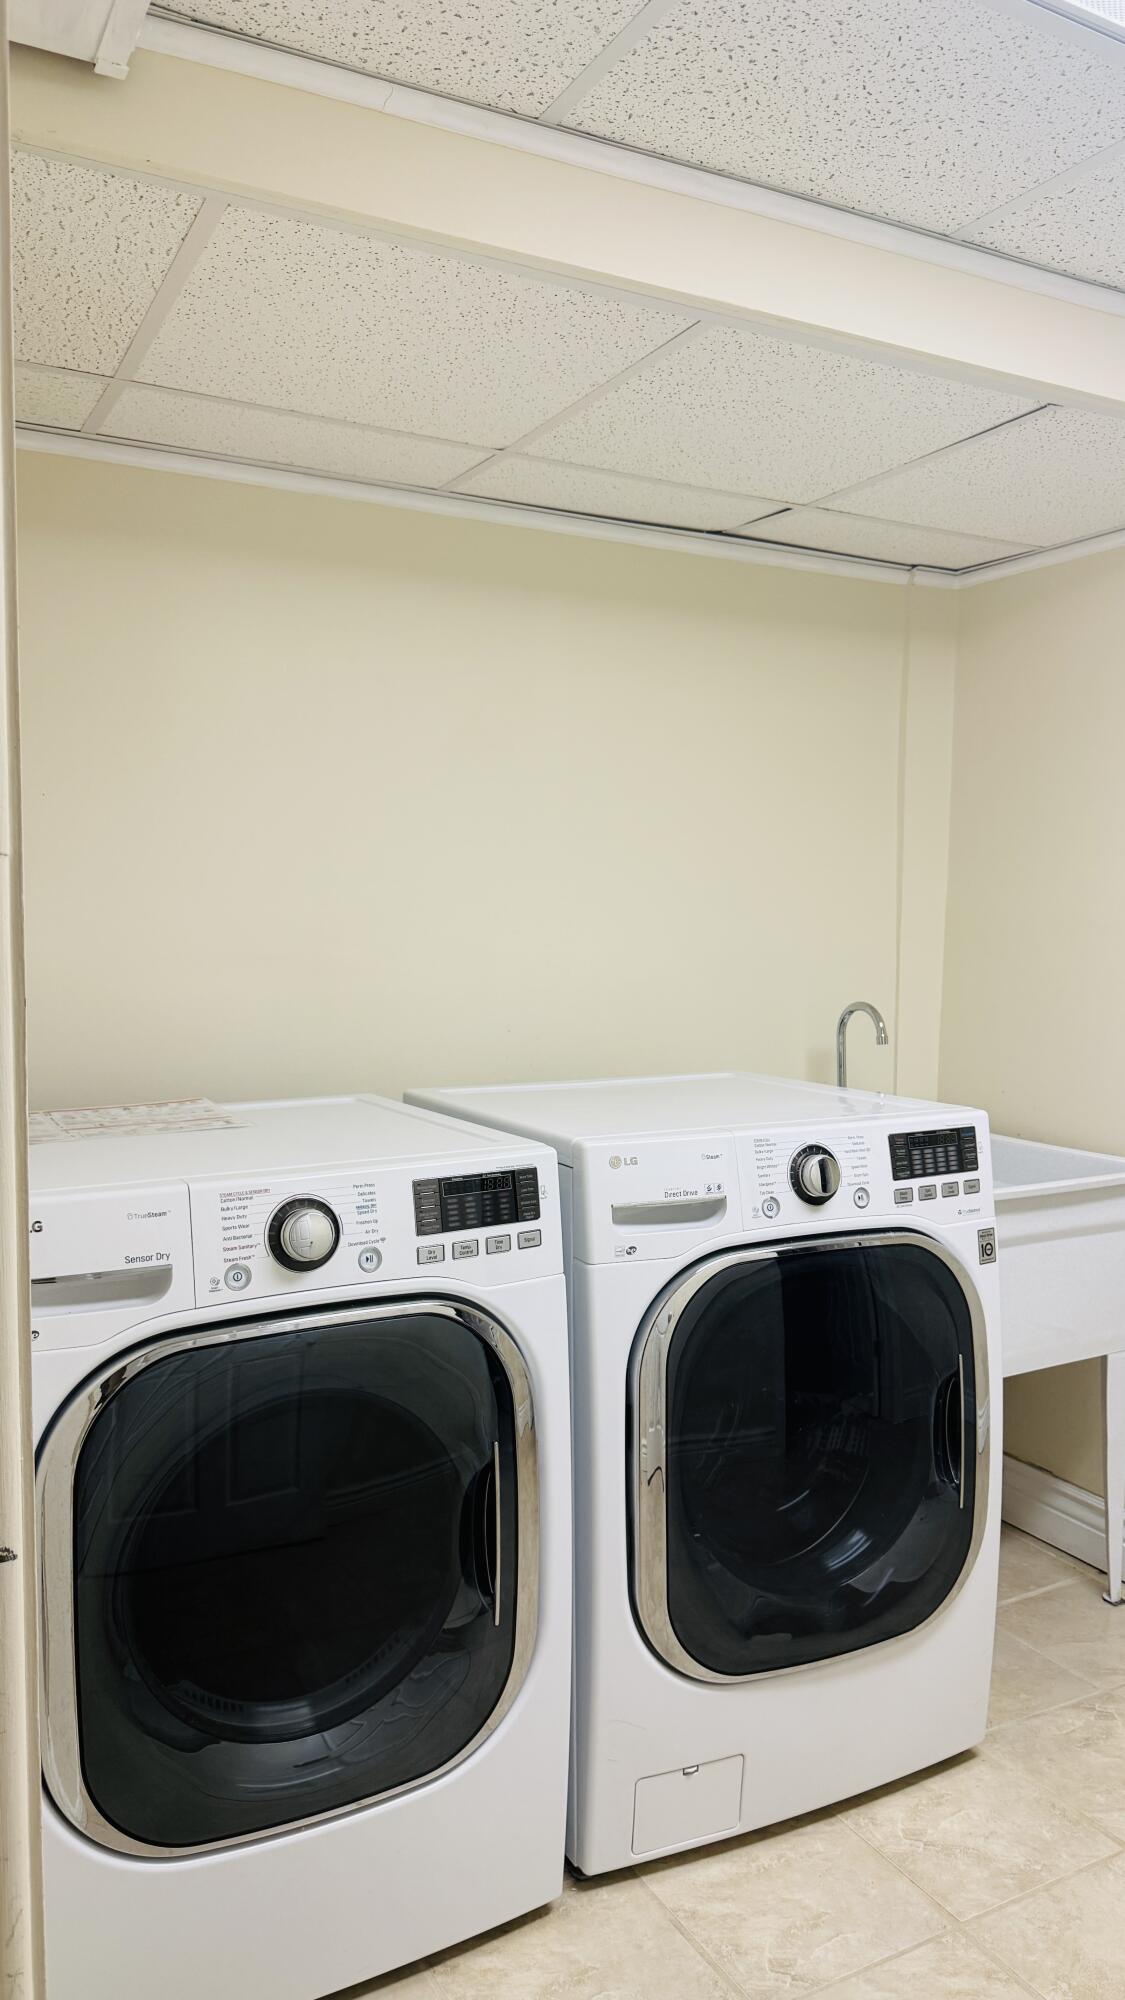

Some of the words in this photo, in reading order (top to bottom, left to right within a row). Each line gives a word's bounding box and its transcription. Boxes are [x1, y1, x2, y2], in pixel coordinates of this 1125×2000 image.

[623, 1156, 638, 1166] LG
[664, 1191, 682, 1199] Direct
[683, 1189, 698, 1197] Drive
[124, 1253, 153, 1265] Sensor
[156, 1252, 171, 1262] Dry
